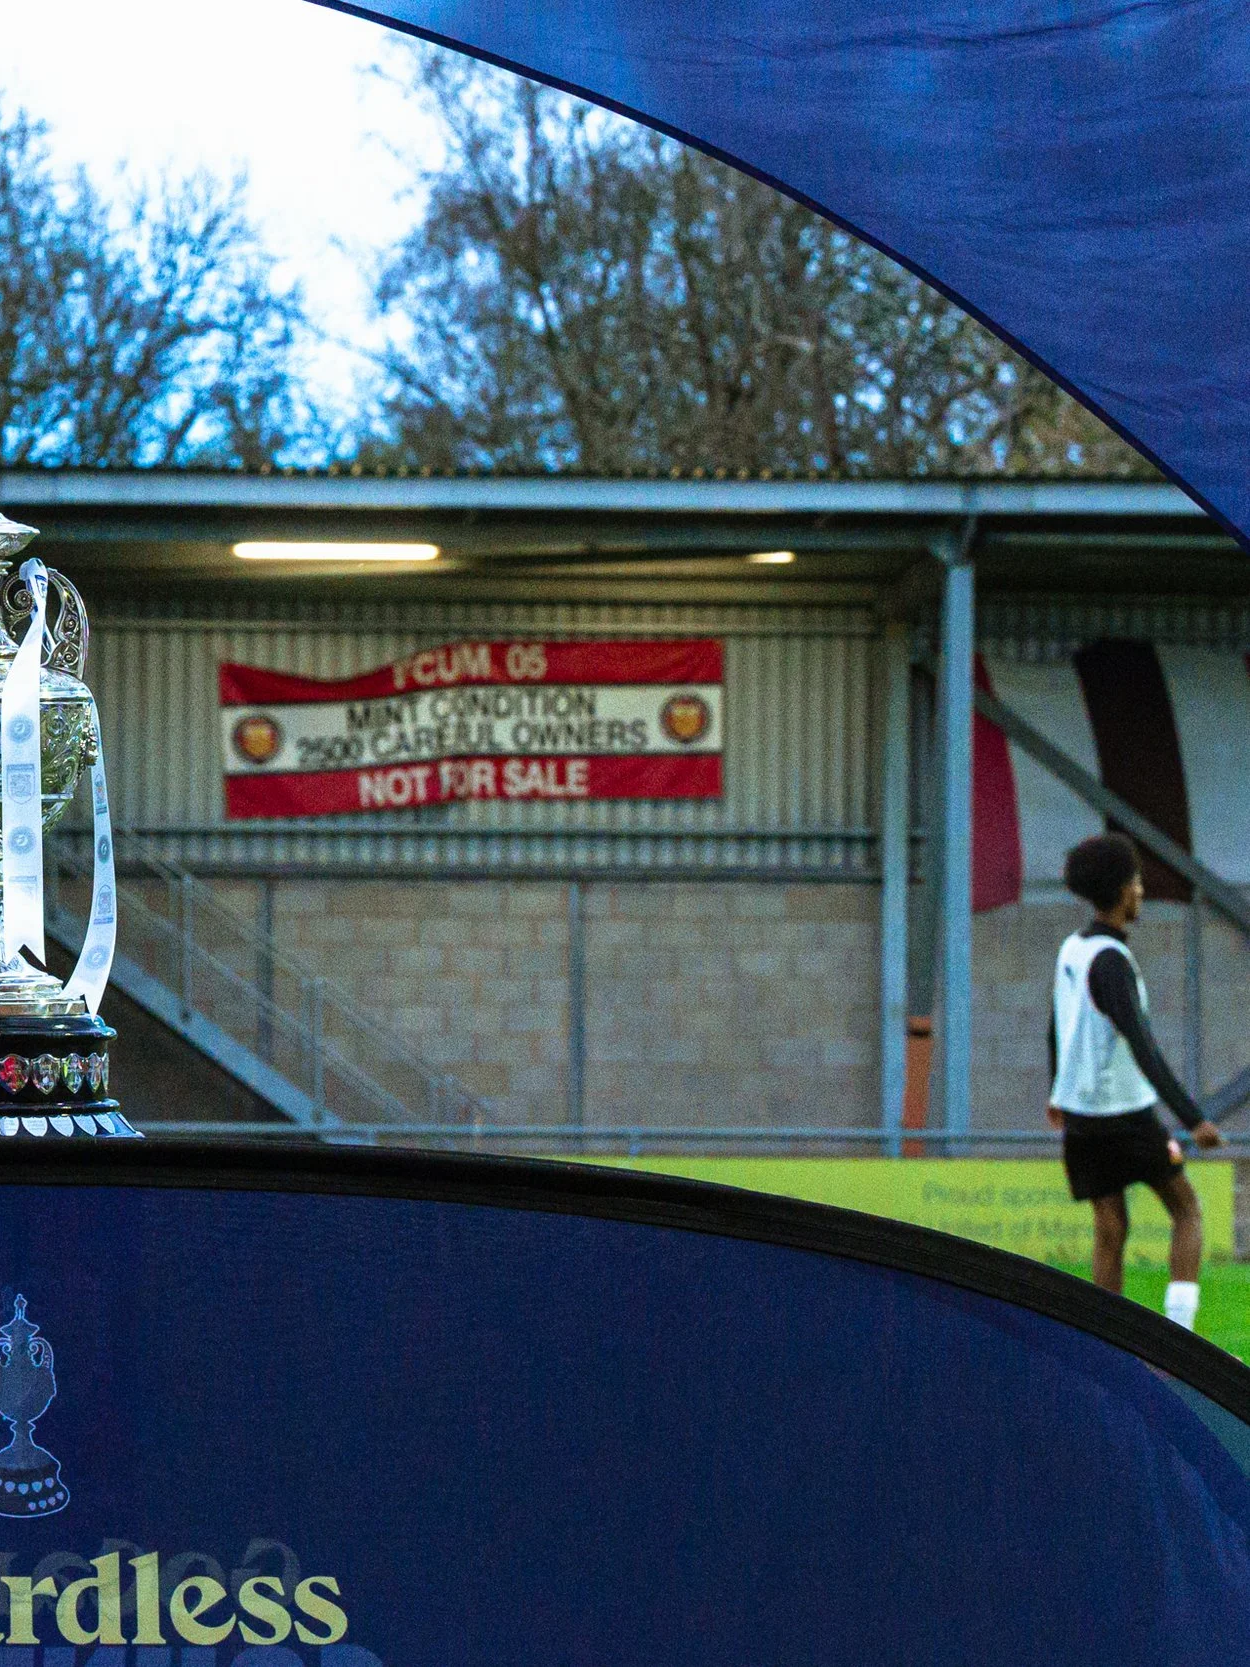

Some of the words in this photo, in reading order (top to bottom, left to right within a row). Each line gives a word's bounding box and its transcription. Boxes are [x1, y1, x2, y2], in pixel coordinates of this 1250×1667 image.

[505, 643, 548, 681] 05
[431, 683, 598, 719] CONDITION
[511, 717, 649, 750] OWNERS
[357, 766, 432, 807] NOT
[501, 757, 590, 798] SALE
